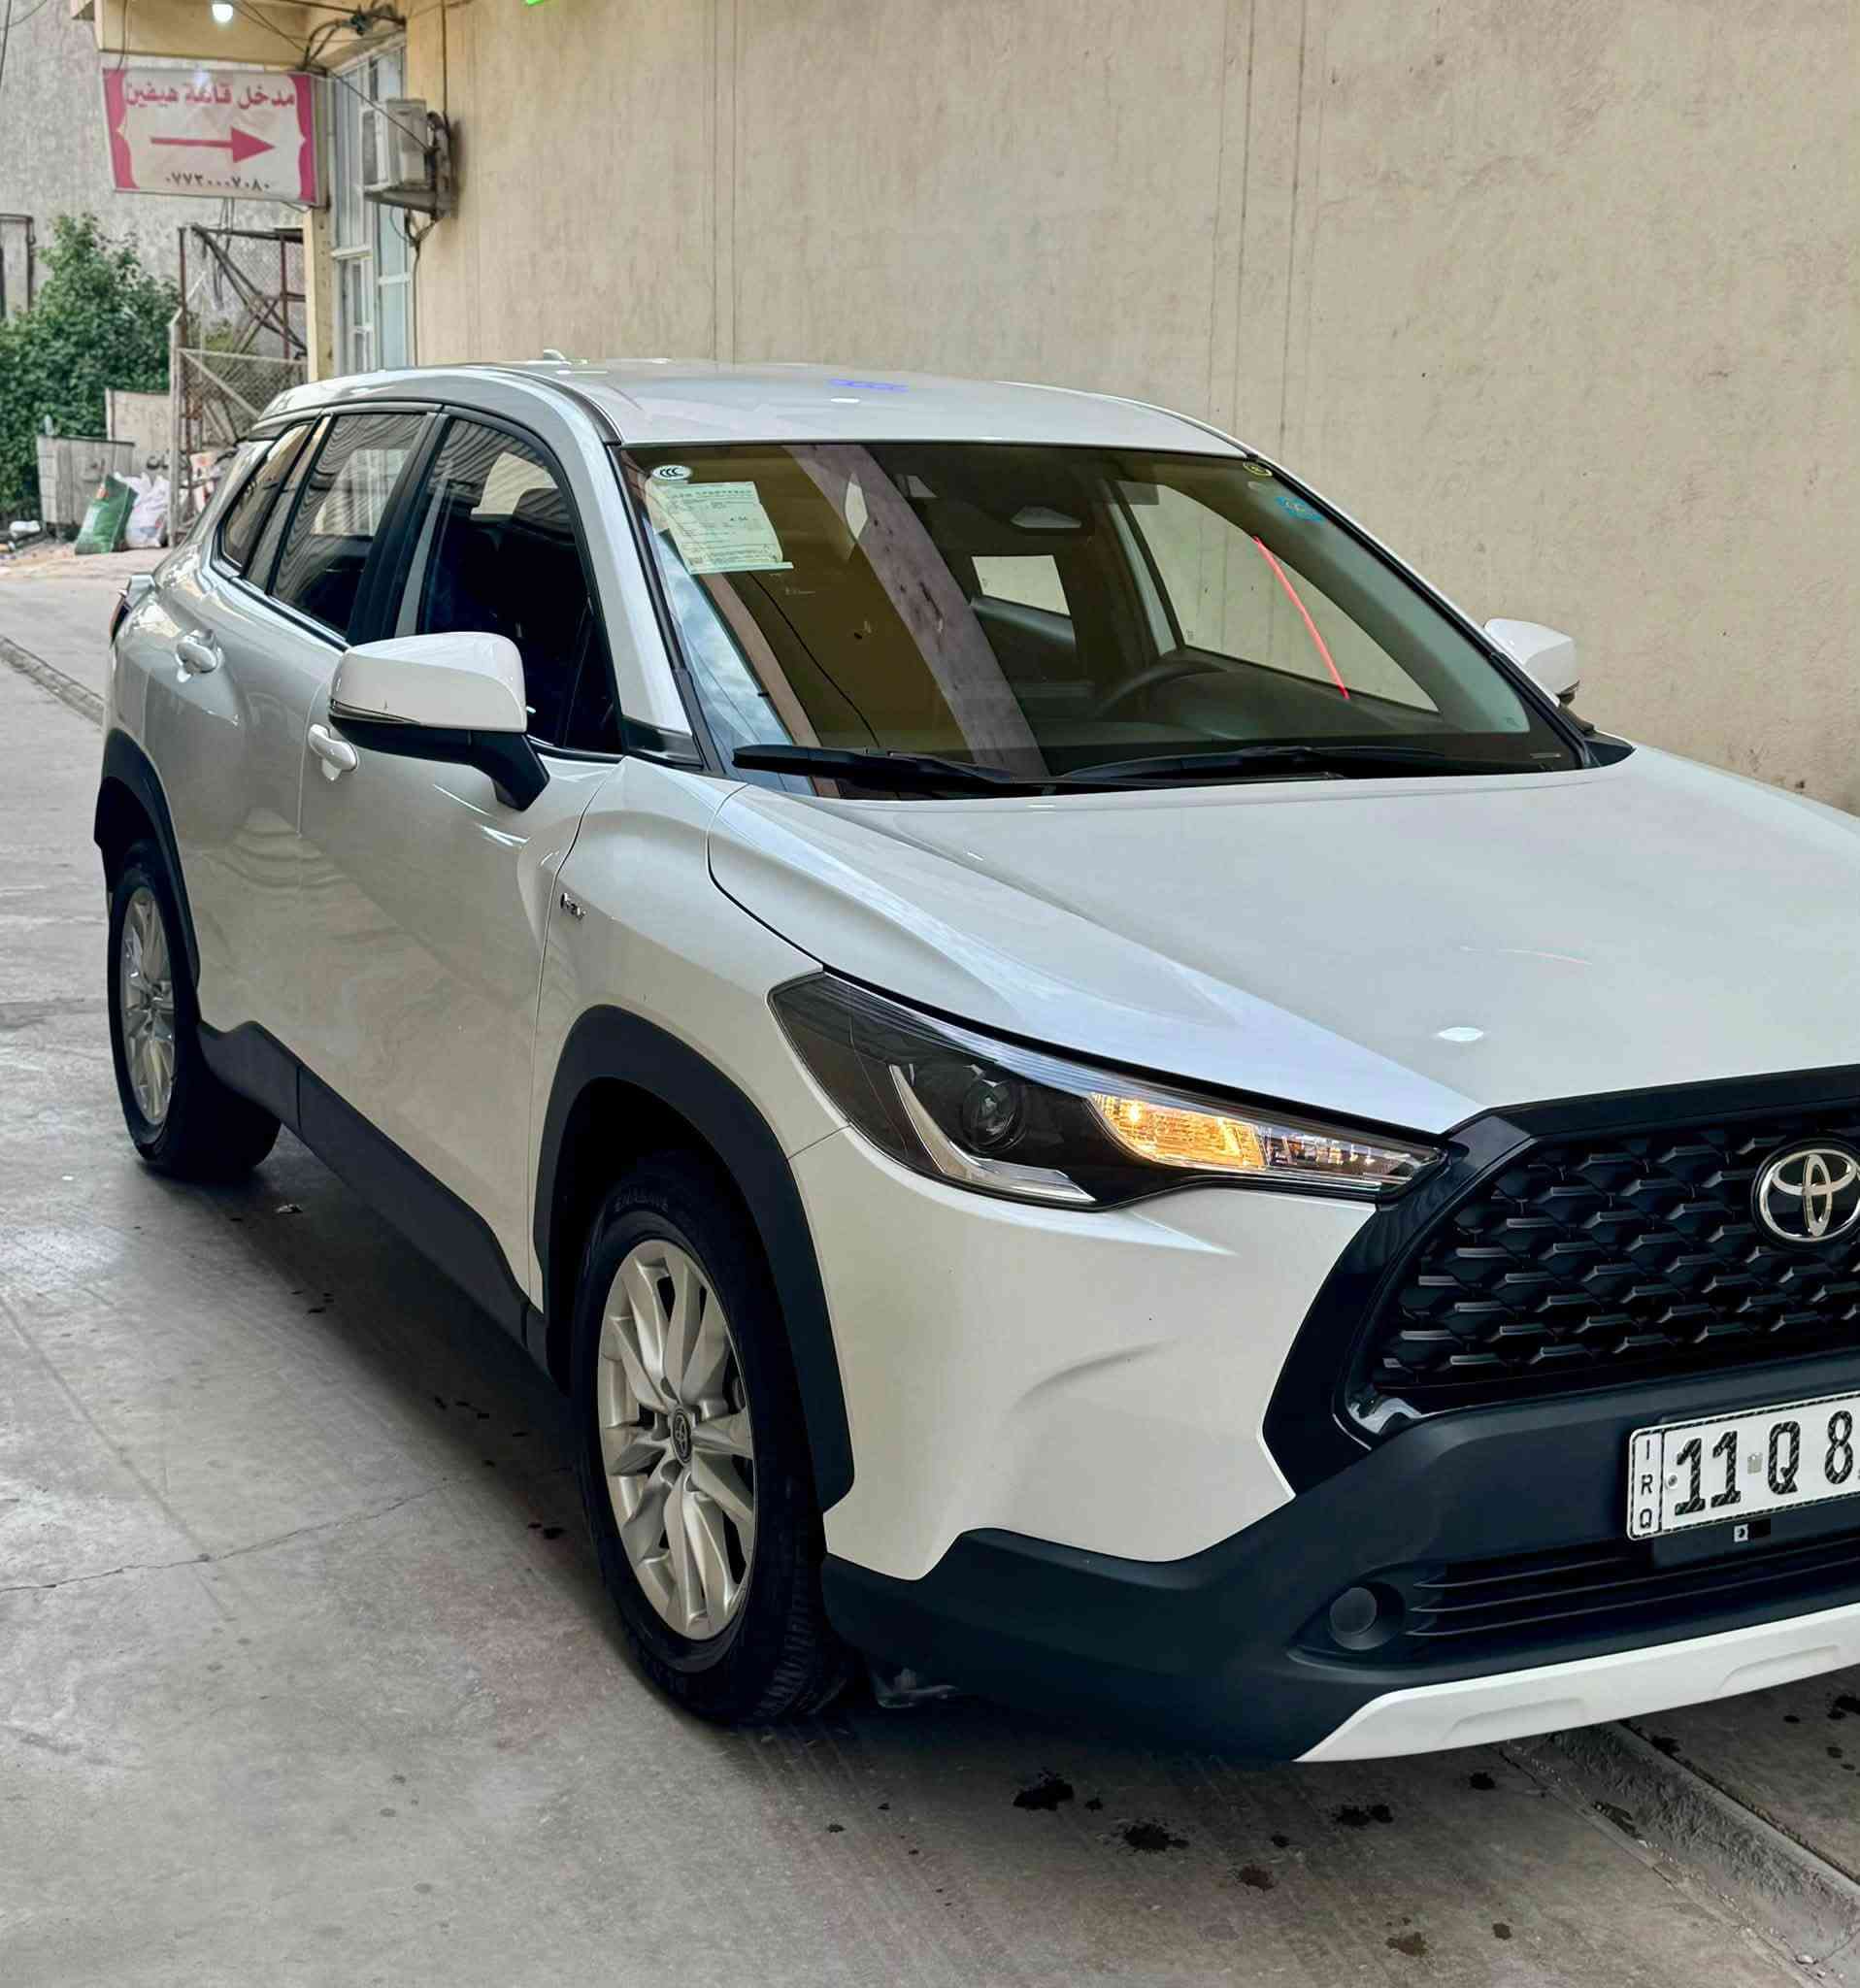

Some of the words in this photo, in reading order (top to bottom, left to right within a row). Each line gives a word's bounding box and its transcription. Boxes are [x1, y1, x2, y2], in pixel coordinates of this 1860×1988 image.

[183, 82, 233, 106] قاعة
[238, 83, 295, 109] مدخل
[1675, 1431, 1742, 1516] 11
[1767, 1420, 1802, 1496] Q
[1824, 1409, 1860, 1485] 8
